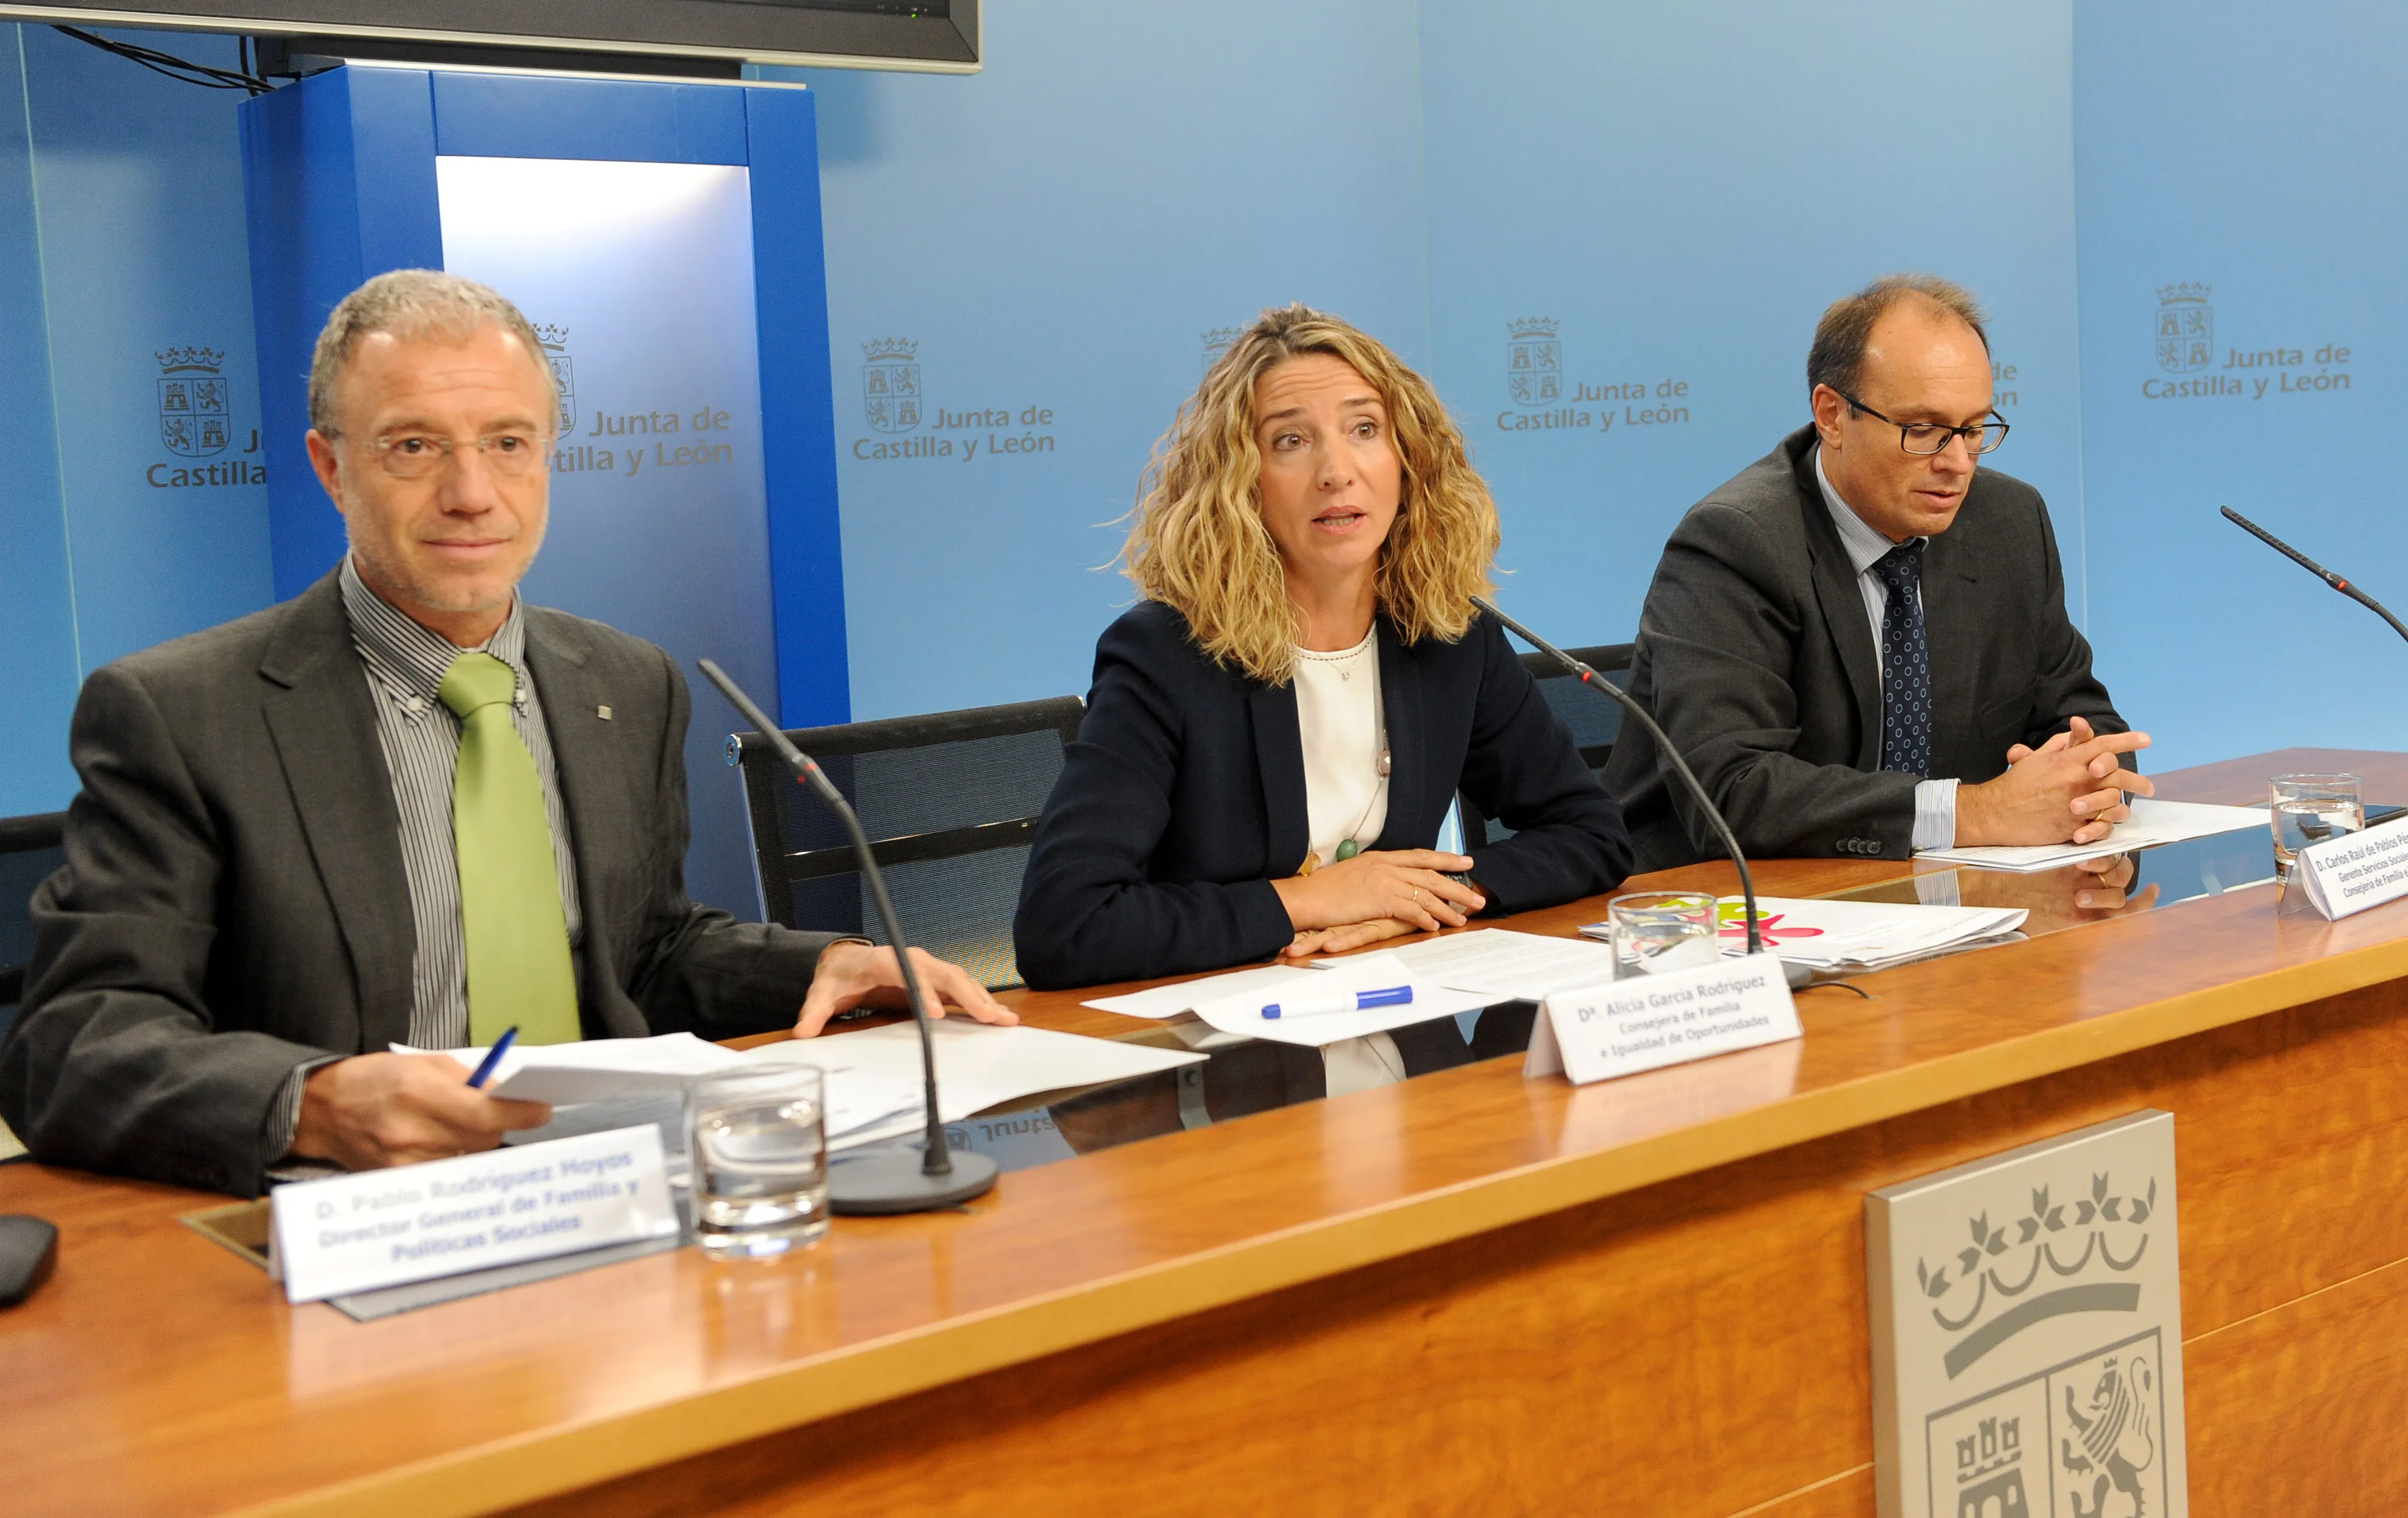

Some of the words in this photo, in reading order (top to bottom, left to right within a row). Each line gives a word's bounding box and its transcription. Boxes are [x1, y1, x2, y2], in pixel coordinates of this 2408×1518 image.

[2223, 348, 2303, 368] Junta
[2315, 343, 2351, 364] de
[1572, 382, 1645, 402] Junta
[1656, 379, 1688, 397] de
[2142, 375, 2242, 398] Castilla
[2252, 377, 2270, 400] y
[2281, 368, 2351, 393] León
[589, 410, 680, 437] Junta
[692, 406, 730, 431] de
[932, 408, 1010, 429] Junta
[1021, 405, 1054, 425] de
[1497, 409, 1590, 431] Castilla
[1600, 411, 1615, 432] y
[1626, 403, 1689, 425] León
[550, 445, 614, 473] tilla
[625, 448, 644, 477] y
[657, 438, 733, 466] León
[853, 436, 952, 459] Castilla
[963, 438, 979, 462] y
[989, 431, 1055, 454] León
[147, 461, 266, 488] Castilla
[2316, 860, 2326, 872] D.
[2325, 854, 2350, 869] Carlos
[2348, 846, 2367, 862] Raúl
[2365, 844, 2377, 856] de
[2374, 837, 2398, 853] Pablos
[2339, 867, 2364, 882] Gerente
[2361, 859, 2390, 875] Servicios
[2374, 876, 2384, 887] de
[2382, 869, 2404, 885] Familia
[1607, 999, 1646, 1016] Alicia
[1619, 1015, 1679, 1035] Consejera
[1683, 1010, 1697, 1021] de
[1699, 1001, 1741, 1018] Familia
[1600, 1050, 1608, 1059] e
[1610, 1034, 1666, 1057] Igualdad
[1669, 1032, 1683, 1045] de
[1686, 1015, 1770, 1041] Oportunidades
[351, 1189, 423, 1213] Pablo
[560, 1152, 633, 1177] Hoyos
[318, 1220, 412, 1248] Director
[417, 1197, 504, 1230] General
[511, 1194, 537, 1213] de
[544, 1180, 621, 1207] Familia
[493, 1215, 582, 1245] Sociales
